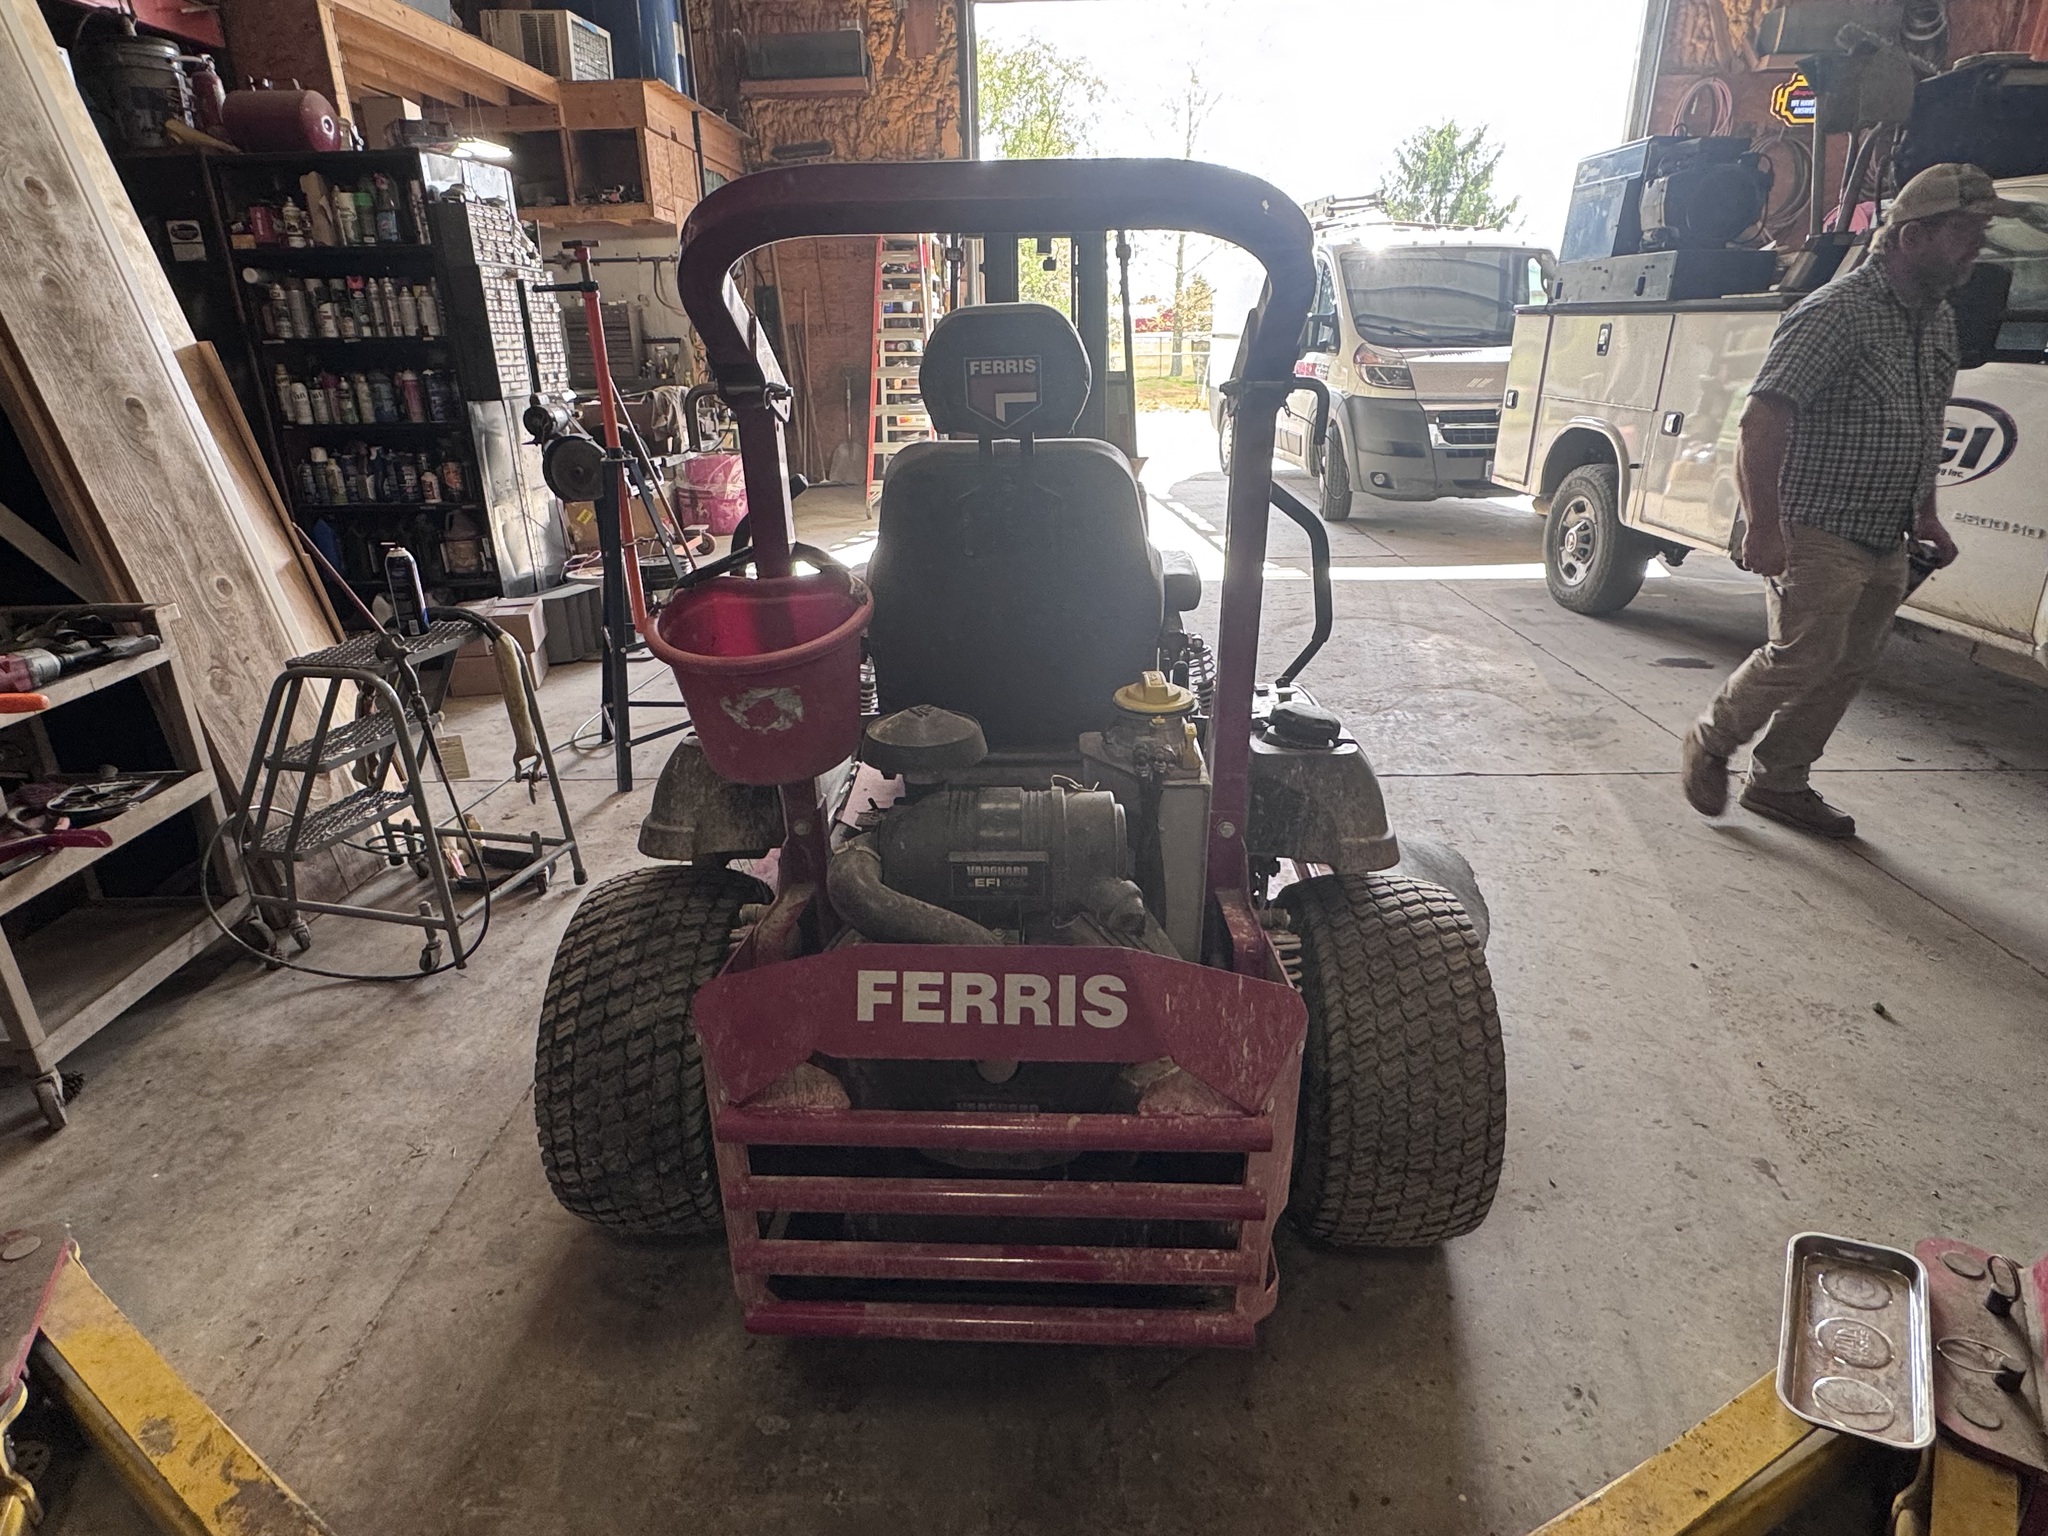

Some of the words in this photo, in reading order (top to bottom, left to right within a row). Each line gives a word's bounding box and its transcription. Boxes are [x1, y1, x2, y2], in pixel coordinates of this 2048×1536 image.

[969, 358, 1037, 375] FERRIS
[974, 877, 1001, 888] EFI
[857, 970, 1128, 1028] FERRIS
